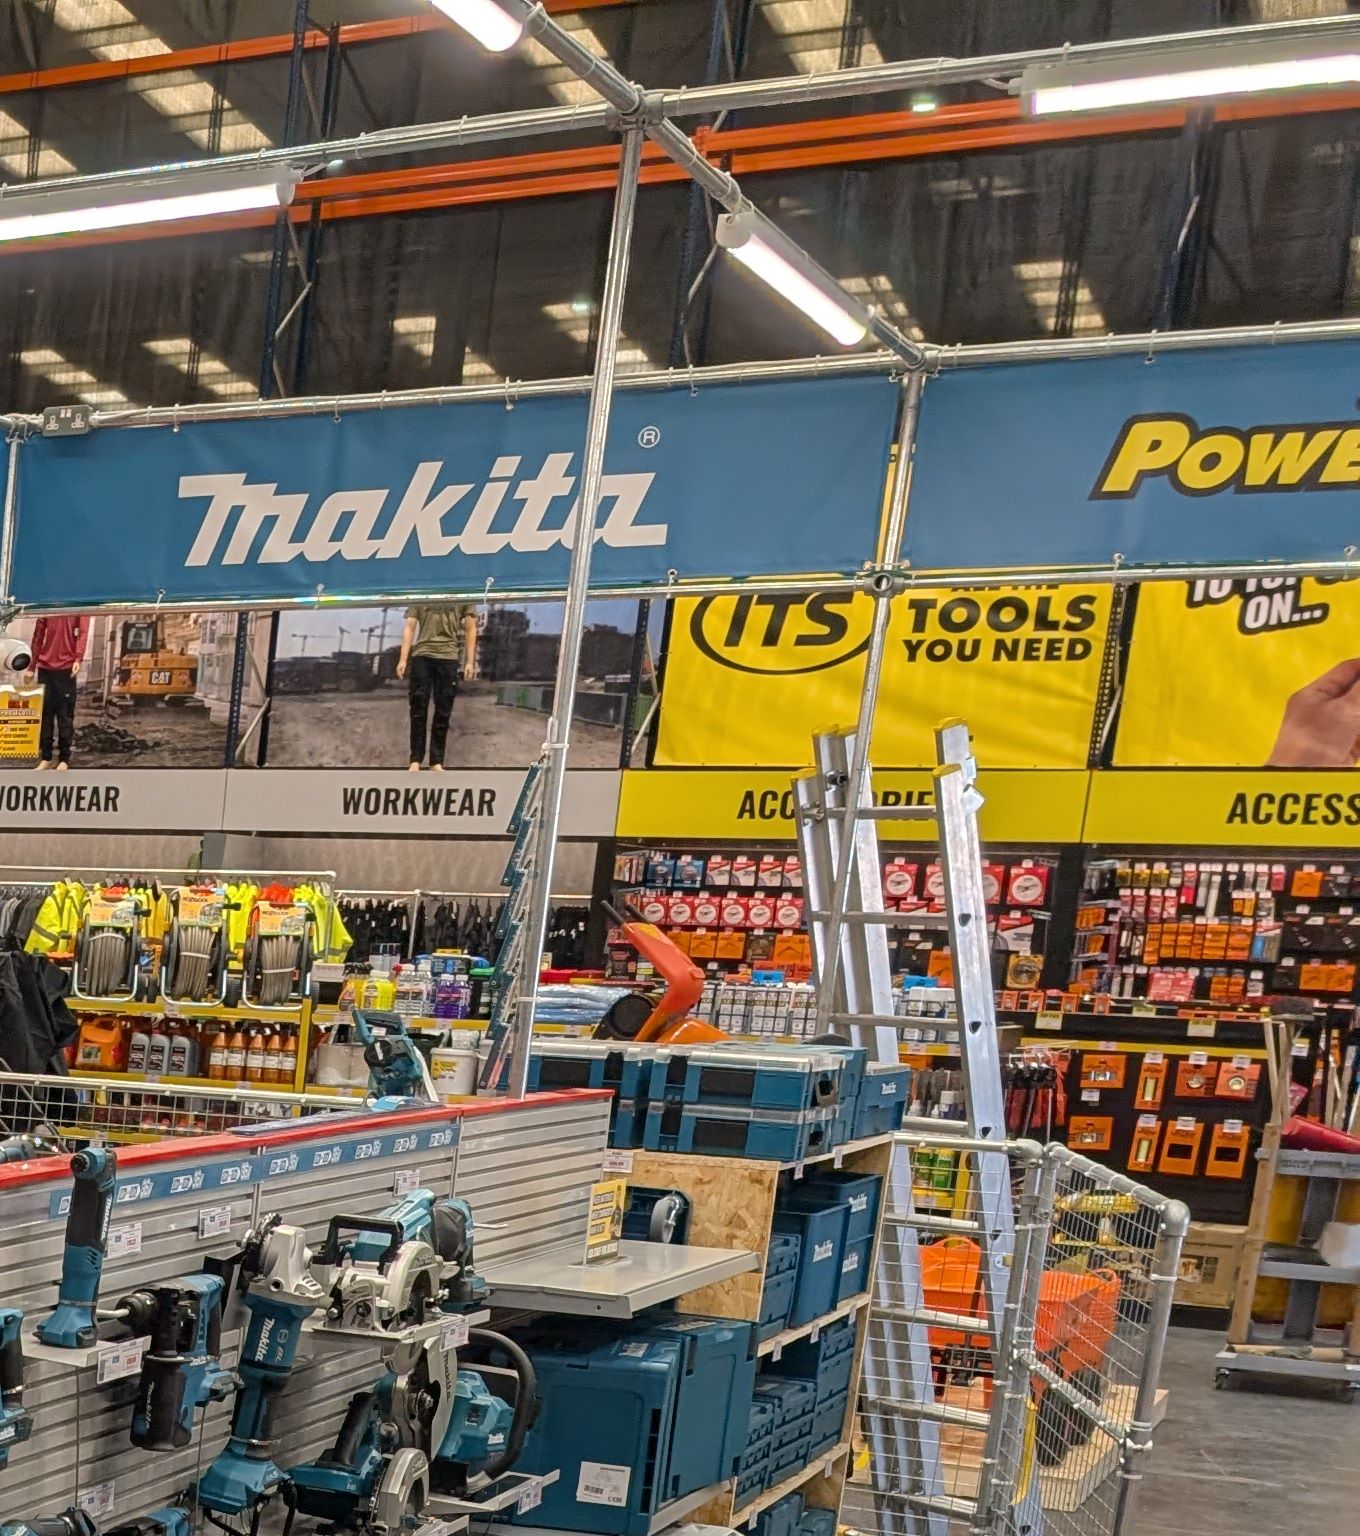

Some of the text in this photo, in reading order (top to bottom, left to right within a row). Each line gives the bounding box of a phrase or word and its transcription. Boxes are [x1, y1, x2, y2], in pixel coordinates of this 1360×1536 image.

[723, 594, 849, 648] ITS
[908, 594, 1097, 634] TOOLS
[902, 637, 1093, 663] YOU NEED
[149, 671, 171, 685] CAT
[342, 787, 496, 818] WORKWEAR
[254, 1317, 276, 1362] Makita
